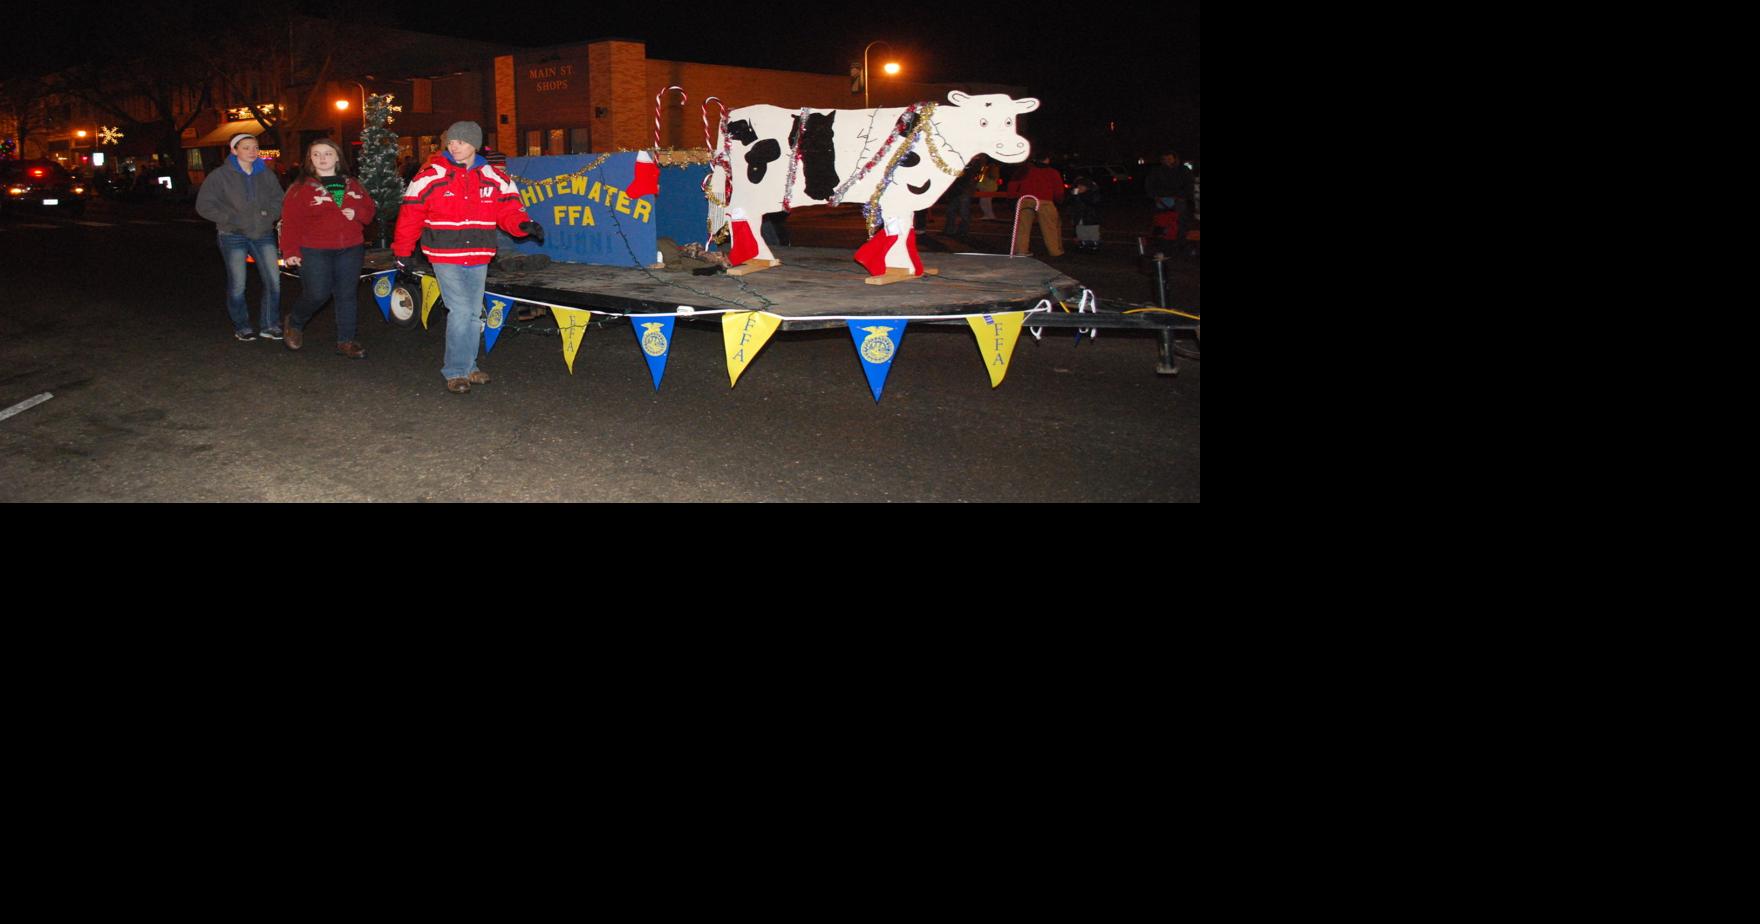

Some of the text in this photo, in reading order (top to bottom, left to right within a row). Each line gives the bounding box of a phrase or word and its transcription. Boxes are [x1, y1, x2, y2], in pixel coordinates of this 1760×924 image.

[529, 67, 556, 79] MAIN
[536, 80, 568, 92] SHOPS
[520, 174, 652, 223] HITEWATER
[553, 205, 596, 226] FFA
[546, 230, 613, 254] LUMNI
[567, 315, 576, 352] FFA
[732, 317, 756, 363] FFA
[992, 322, 1005, 366] FFA
